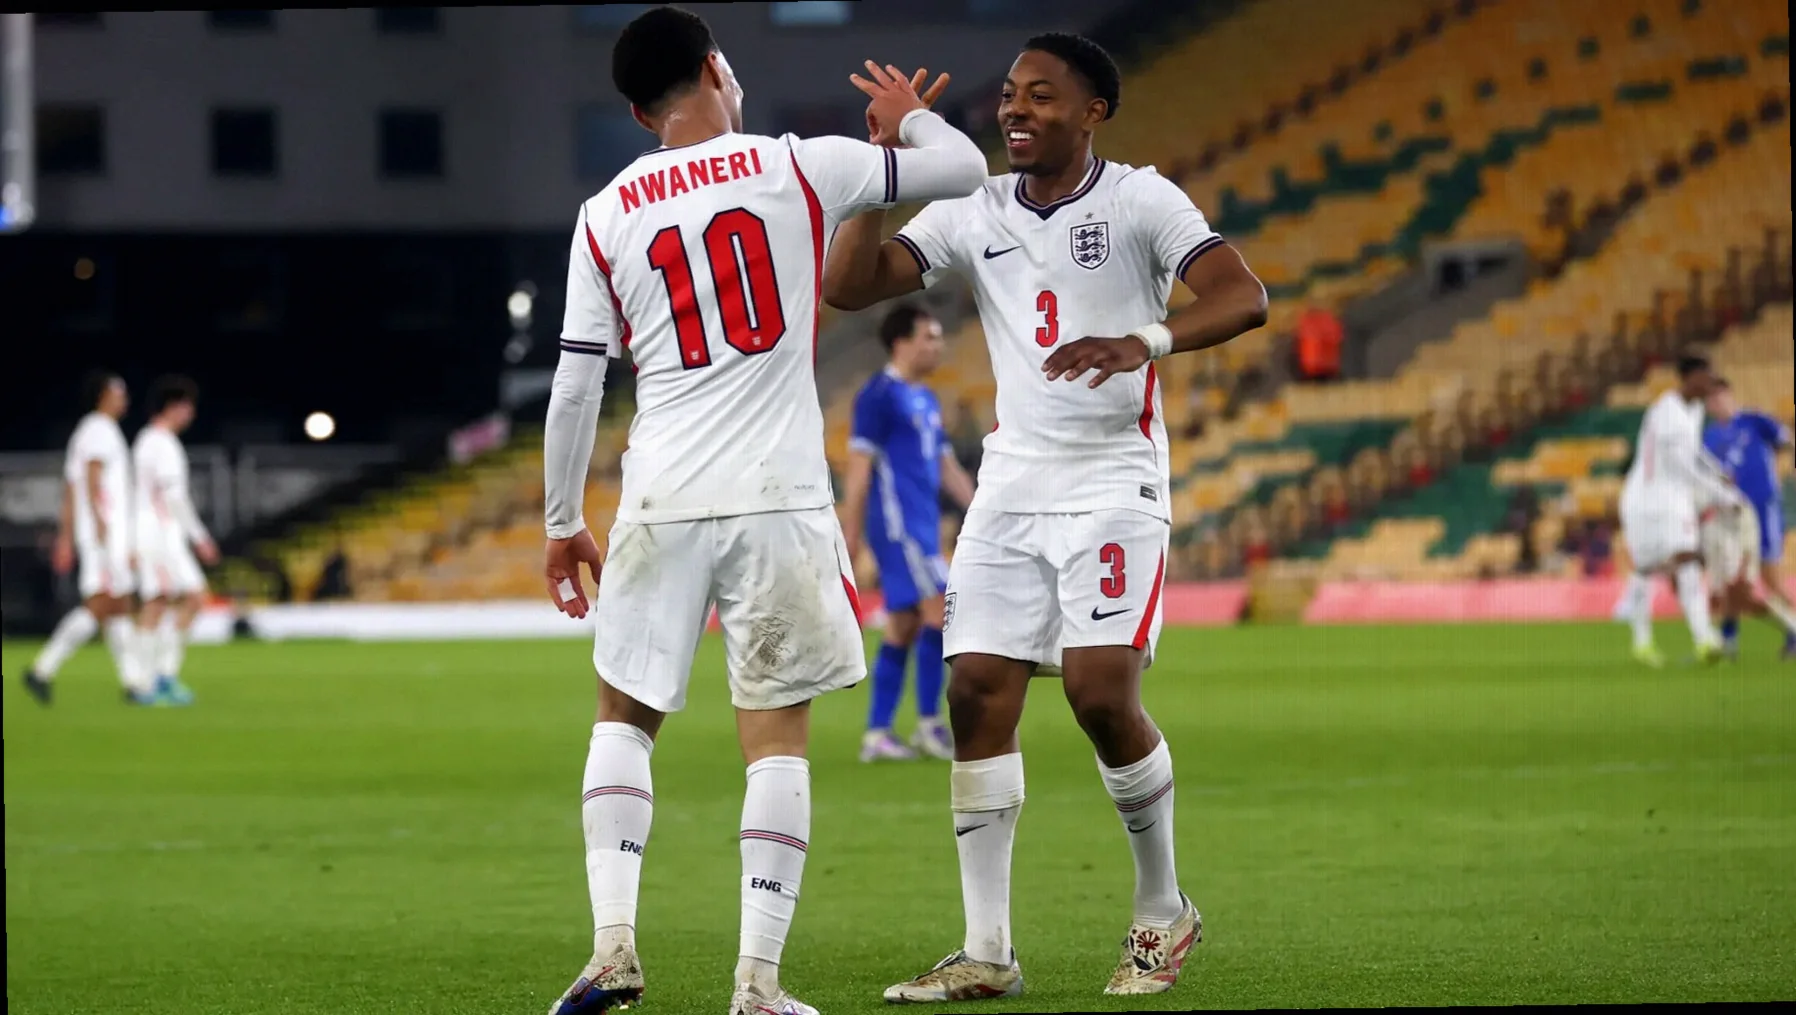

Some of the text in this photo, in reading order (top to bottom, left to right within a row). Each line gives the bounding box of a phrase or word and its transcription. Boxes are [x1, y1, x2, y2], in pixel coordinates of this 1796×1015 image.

[618, 148, 763, 214] NWANERI
[646, 206, 787, 371] 10
[1035, 290, 1059, 348] 3
[1100, 542, 1126, 599] 3
[751, 877, 782, 893] ENG
